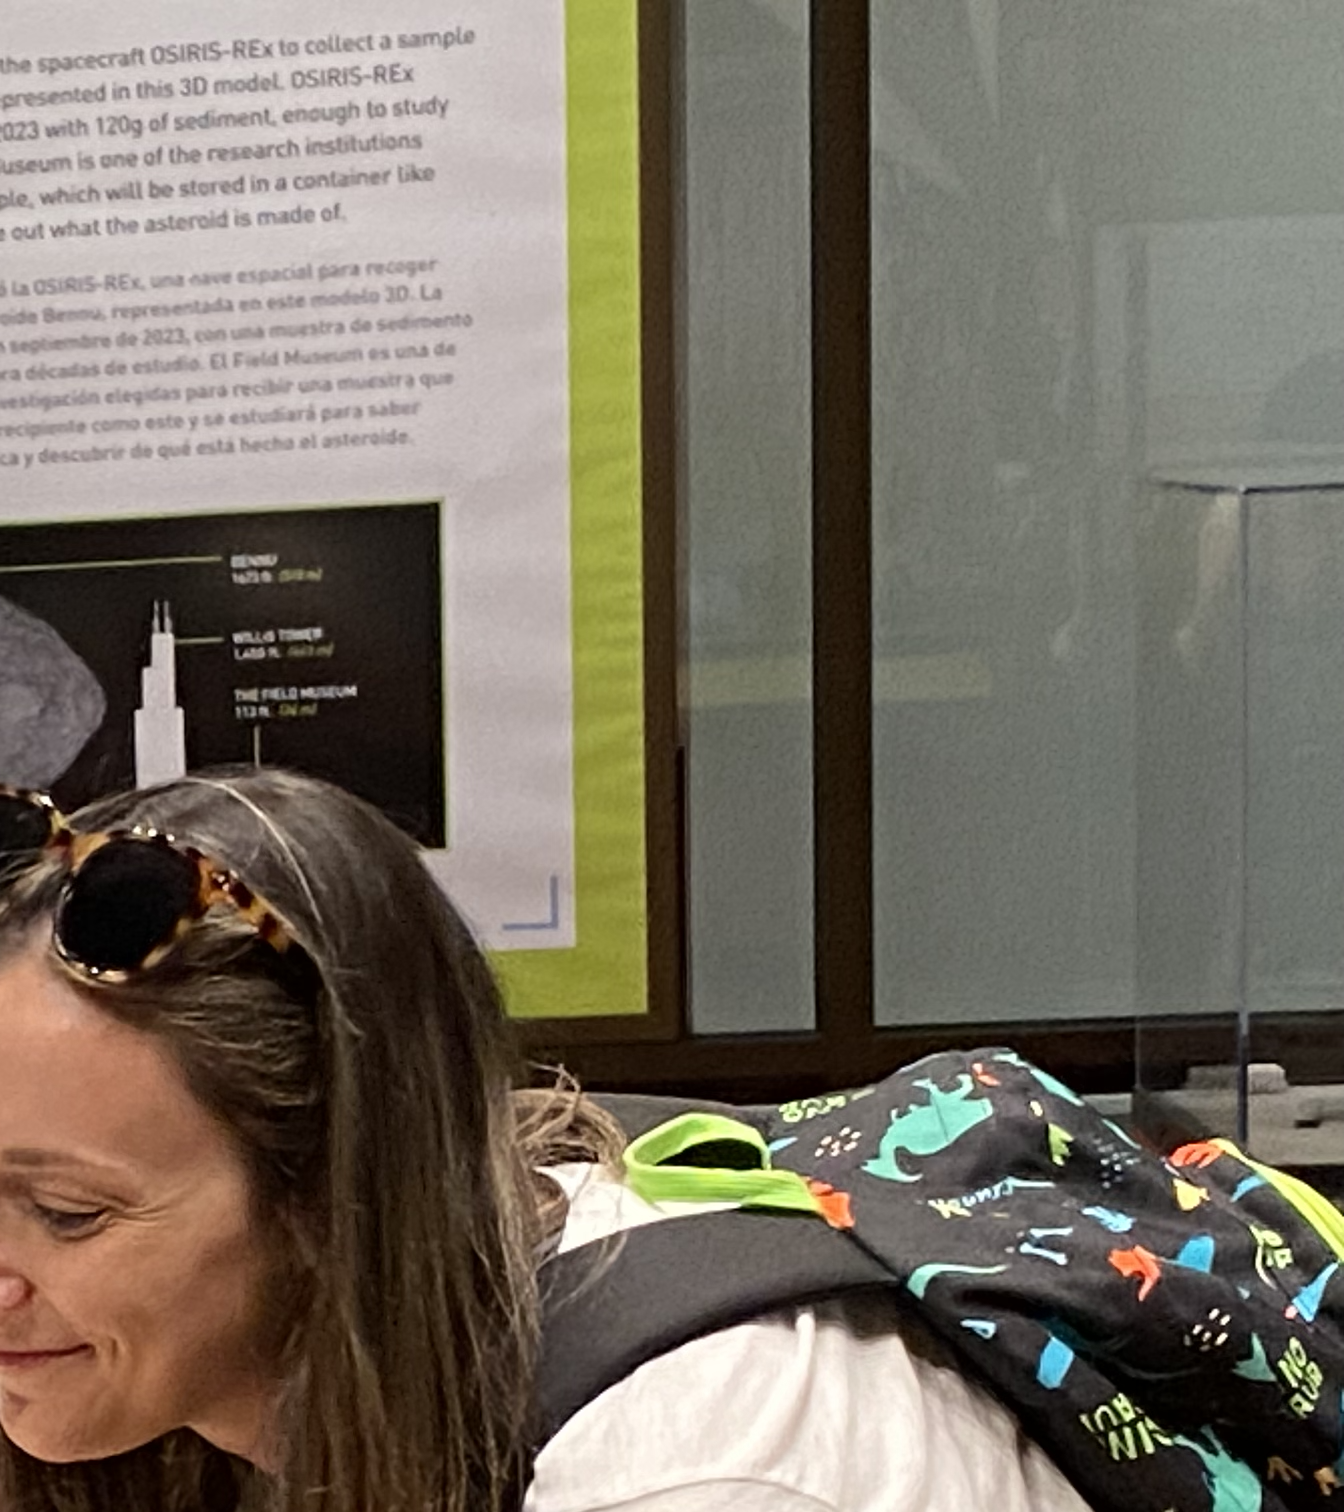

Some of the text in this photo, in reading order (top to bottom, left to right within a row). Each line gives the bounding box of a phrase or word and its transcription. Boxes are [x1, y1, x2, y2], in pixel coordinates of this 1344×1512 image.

[37, 45, 145, 76] spacecraft
[150, 37, 273, 64] OSIRIS-REx
[278, 38, 300, 56] to
[304, 31, 374, 54] collect
[380, 34, 392, 49] a
[397, 24, 476, 53] sample
[112, 80, 131, 101] in
[136, 78, 175, 99] this
[180, 76, 208, 96] 3D
[290, 63, 414, 90] OSIRIS-REx
[44, 117, 89, 139] with
[97, 114, 144, 140] 120g
[149, 112, 169, 132] of
[282, 101, 361, 129] enough
[366, 102, 387, 119] to
[392, 96, 449, 123] study
[77, 150, 96, 170] is
[100, 152, 139, 169] one
[143, 146, 163, 166] of
[168, 144, 202, 165] the
[206, 138, 301, 162] research
[305, 131, 423, 157] institutions
[39, 183, 101, 206] which
[105, 181, 143, 202] will
[148, 179, 174, 199] be
[179, 174, 246, 197] stored
[250, 173, 271, 193] in
[275, 177, 288, 192] a
[292, 166, 391, 191] container
[397, 163, 435, 184] like
[11, 222, 45, 241] out
[50, 216, 101, 238] what
[105, 214, 139, 235] the
[144, 209, 229, 233] asteroid
[234, 208, 252, 228] is
[256, 204, 316, 226] made
